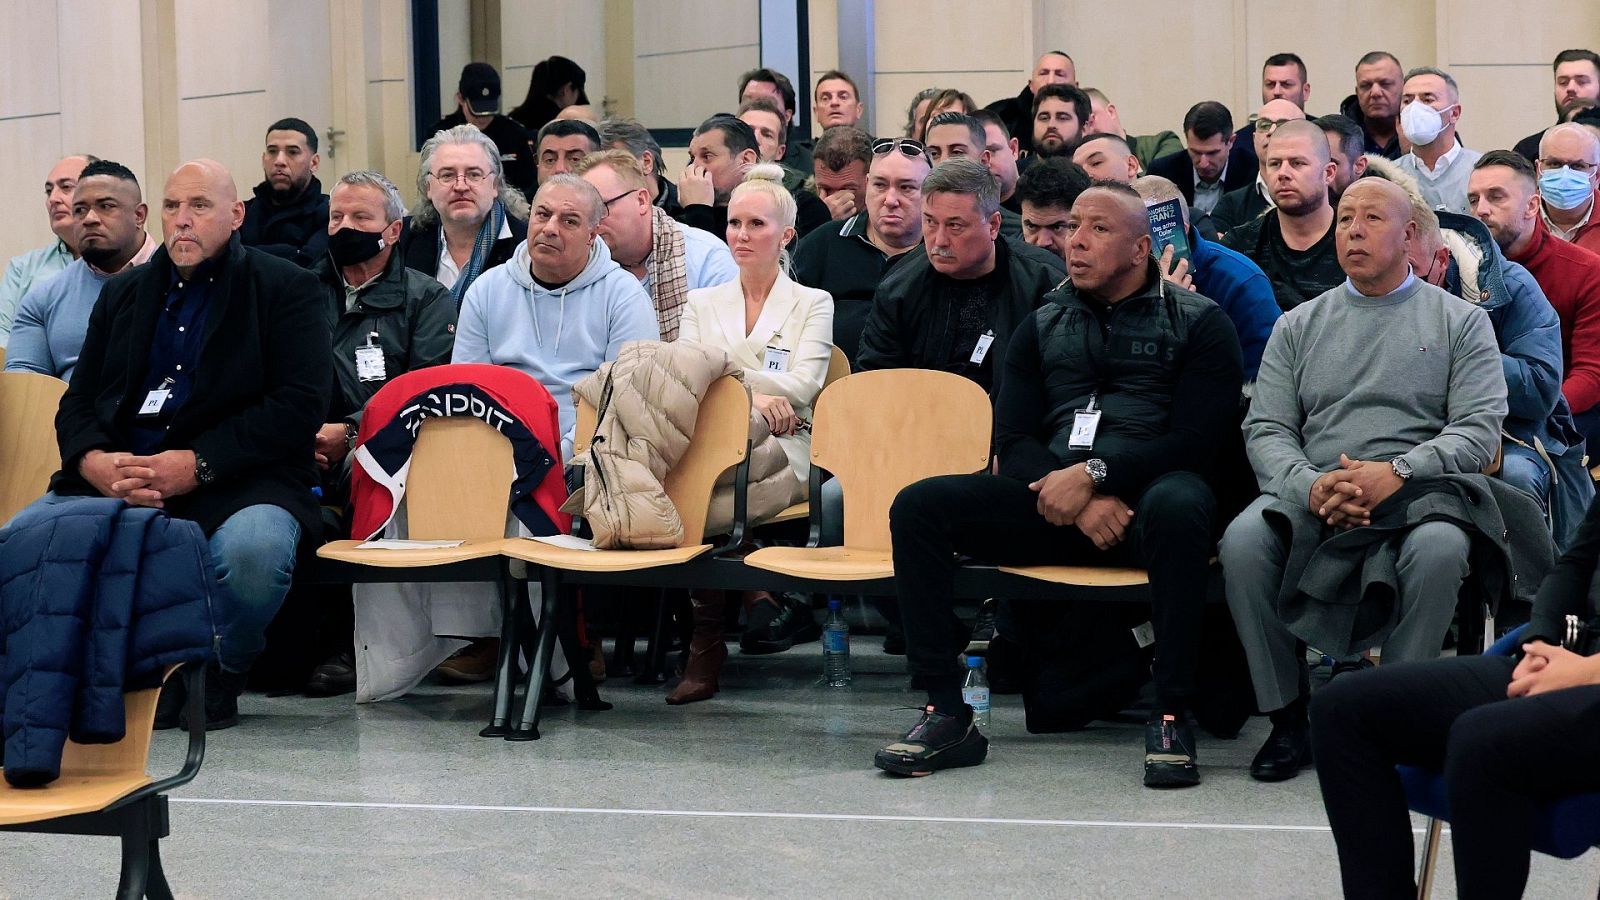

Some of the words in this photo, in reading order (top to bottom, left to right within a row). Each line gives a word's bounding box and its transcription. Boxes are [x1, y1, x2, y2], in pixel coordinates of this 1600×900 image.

[1148, 204, 1174, 216] ANDREAS
[1149, 209, 1176, 224] FRANZ
[769, 361, 782, 370] PL
